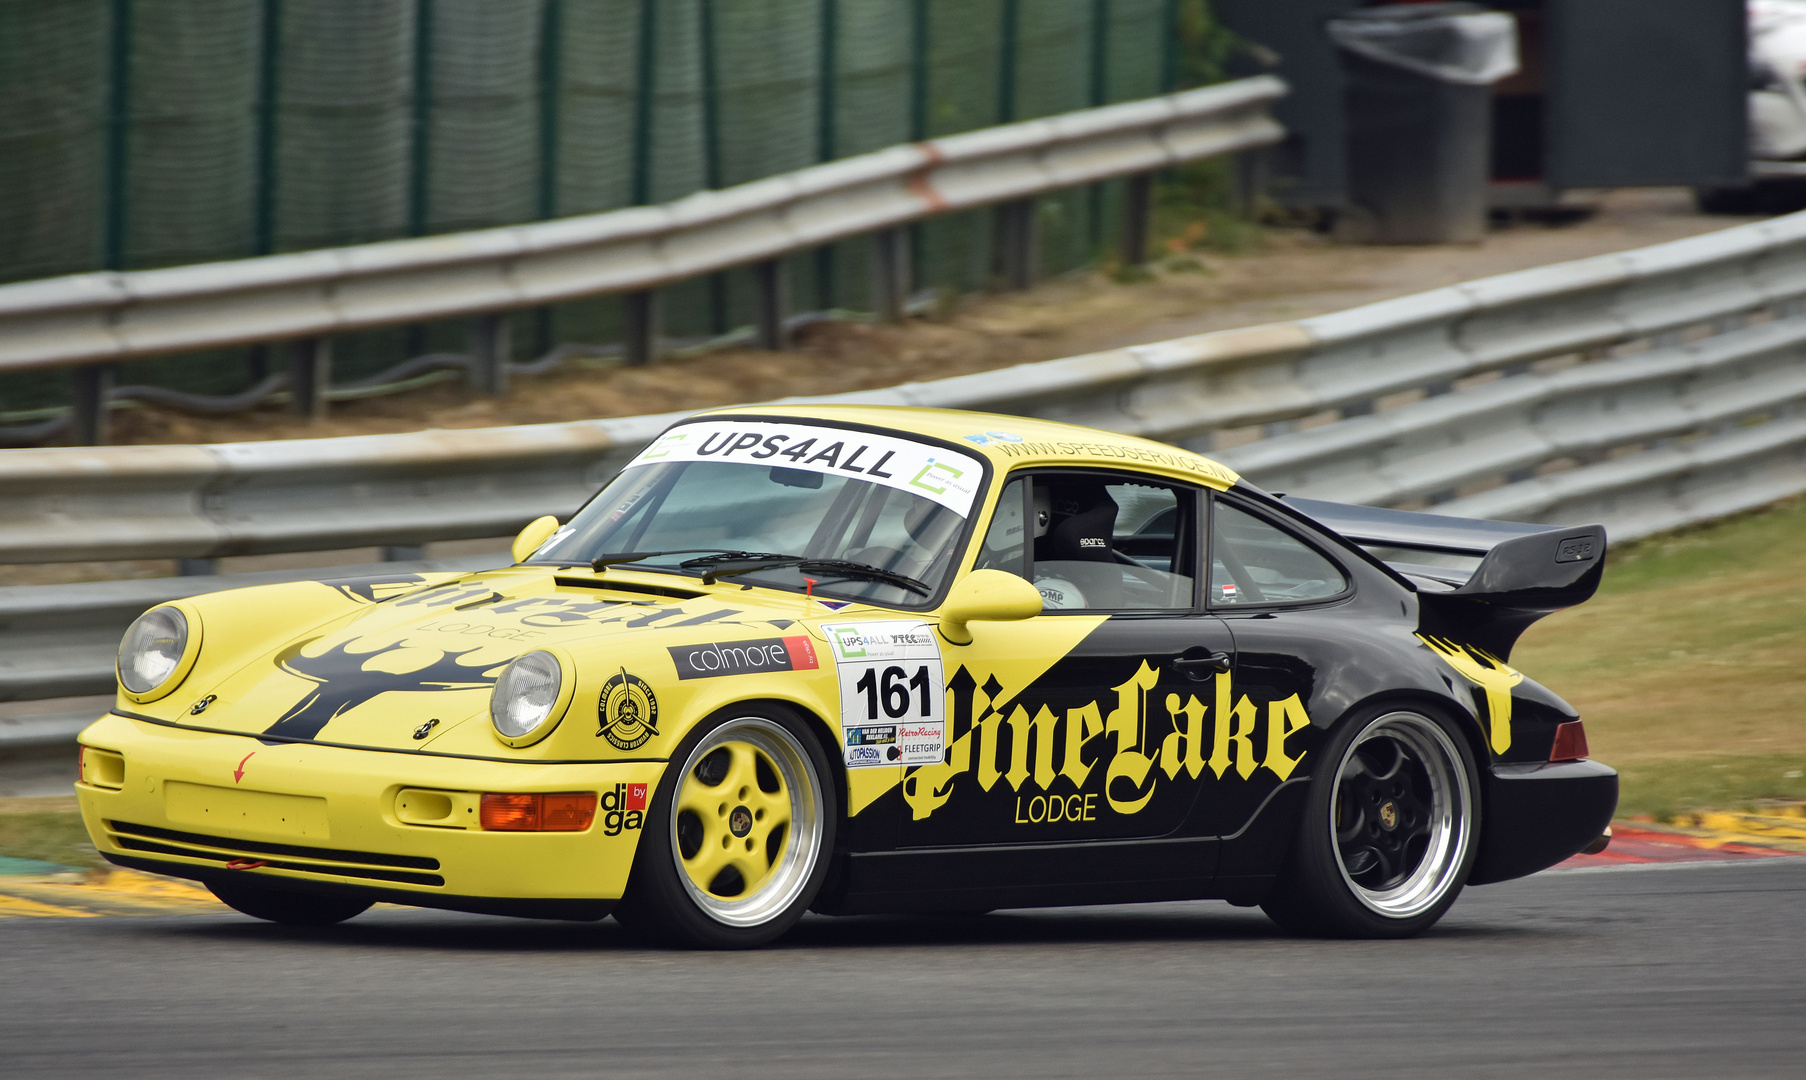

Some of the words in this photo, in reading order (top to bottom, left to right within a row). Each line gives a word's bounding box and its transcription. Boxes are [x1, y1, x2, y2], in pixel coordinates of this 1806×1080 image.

[696, 432, 896, 479] UPS4ALL
[994, 442, 1236, 483] WWW.SPEEDSERVICE.NL
[1039, 590, 1064, 602] OMP
[416, 621, 546, 642] LODGE
[843, 635, 889, 647] UPS4ALL
[689, 642, 786, 671] colmore
[856, 666, 931, 720] 161
[905, 743, 941, 753] FLEETGRIP
[633, 786, 646, 798] by
[1015, 793, 1098, 824] LODGE
